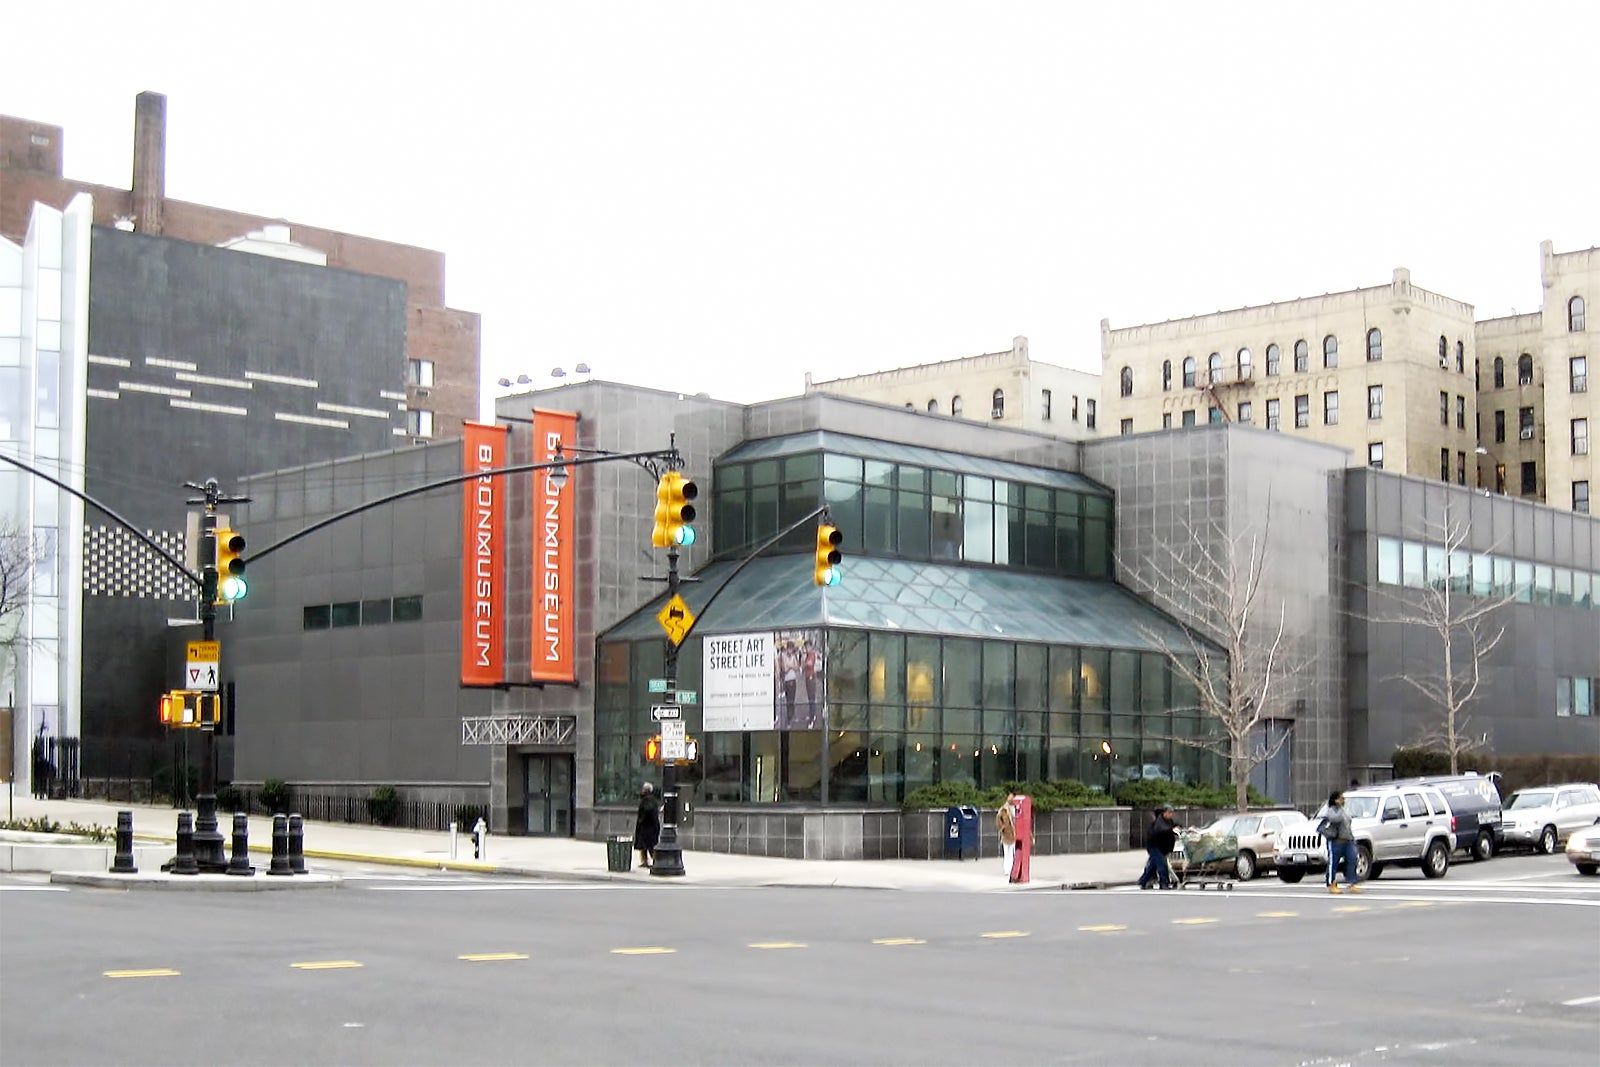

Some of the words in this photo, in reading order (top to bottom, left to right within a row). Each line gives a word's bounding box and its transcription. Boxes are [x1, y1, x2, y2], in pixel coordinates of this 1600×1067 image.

[710, 639, 743, 655] STREET
[746, 637, 765, 652] ART
[710, 655, 742, 670] STREET
[745, 654, 765, 668] LIFE
